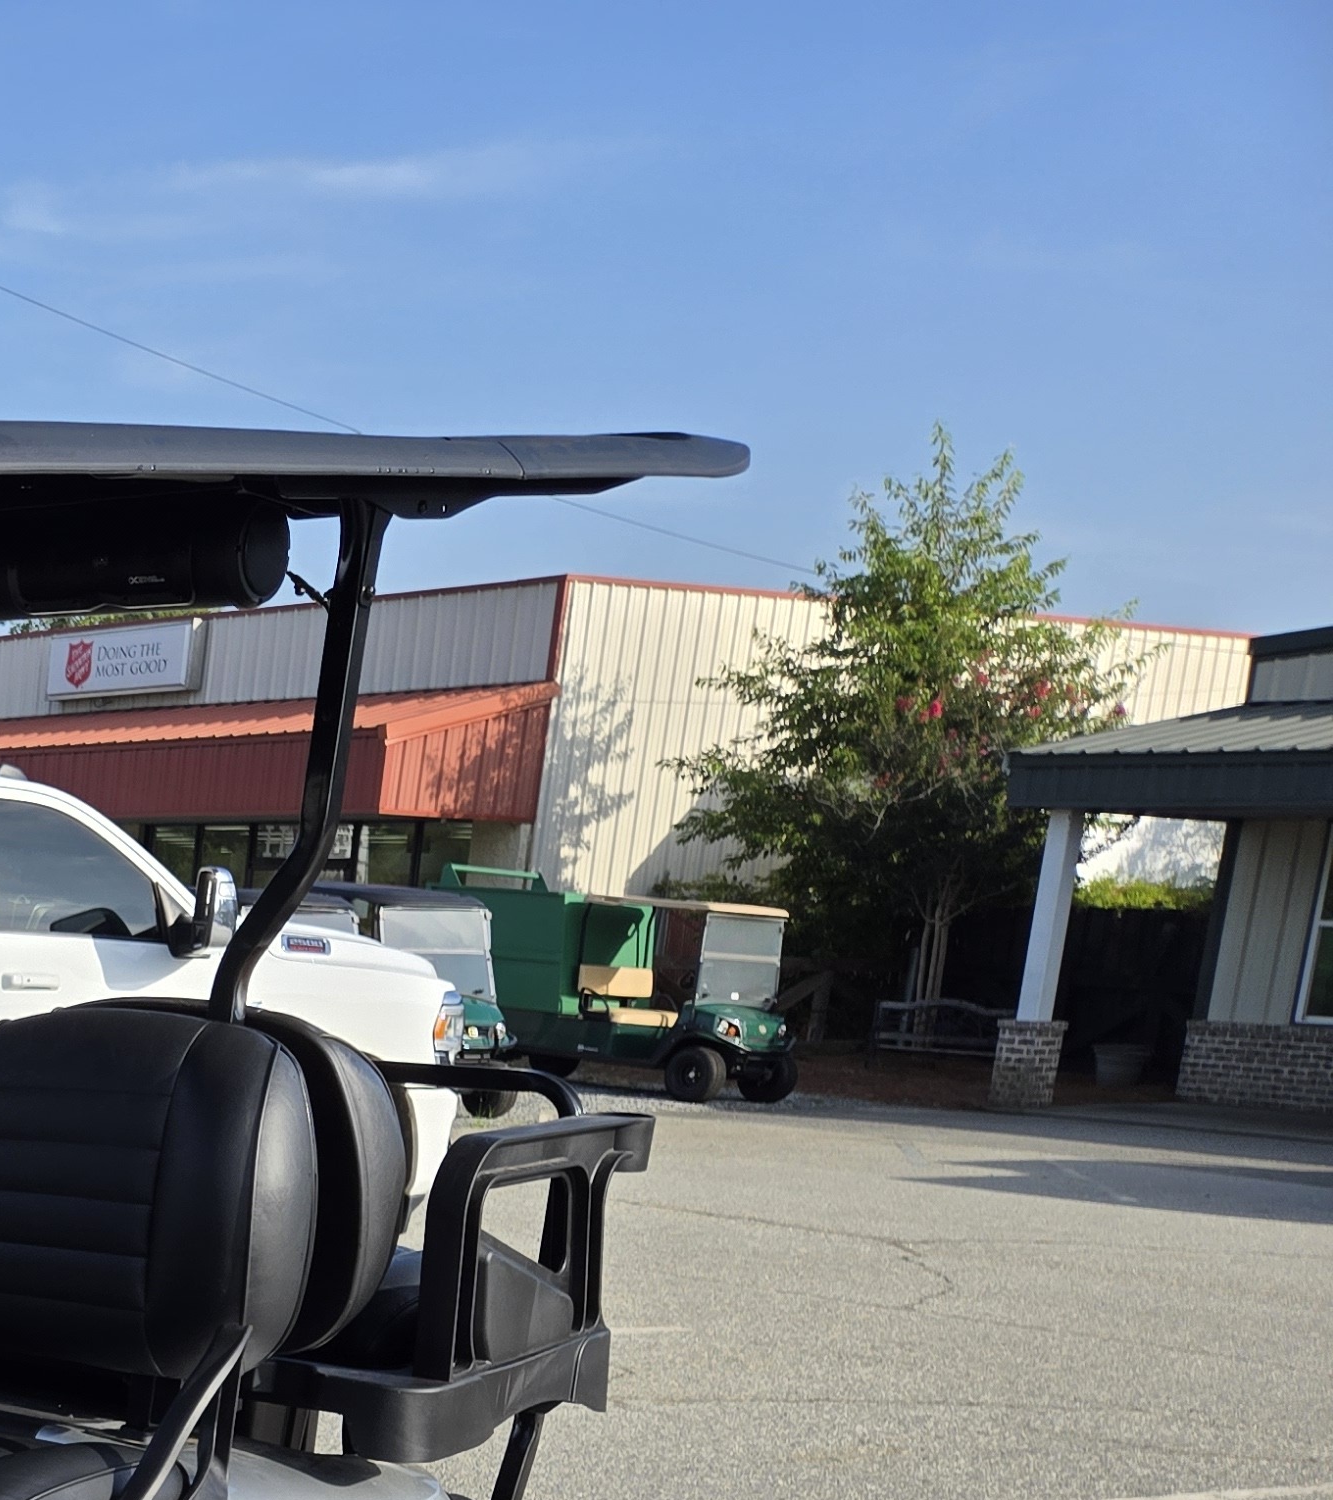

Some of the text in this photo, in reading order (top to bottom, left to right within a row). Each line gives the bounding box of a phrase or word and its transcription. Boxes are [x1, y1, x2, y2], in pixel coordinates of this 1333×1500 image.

[97, 642, 162, 661] DOING THE
[95, 659, 168, 677] MOST GOOD
